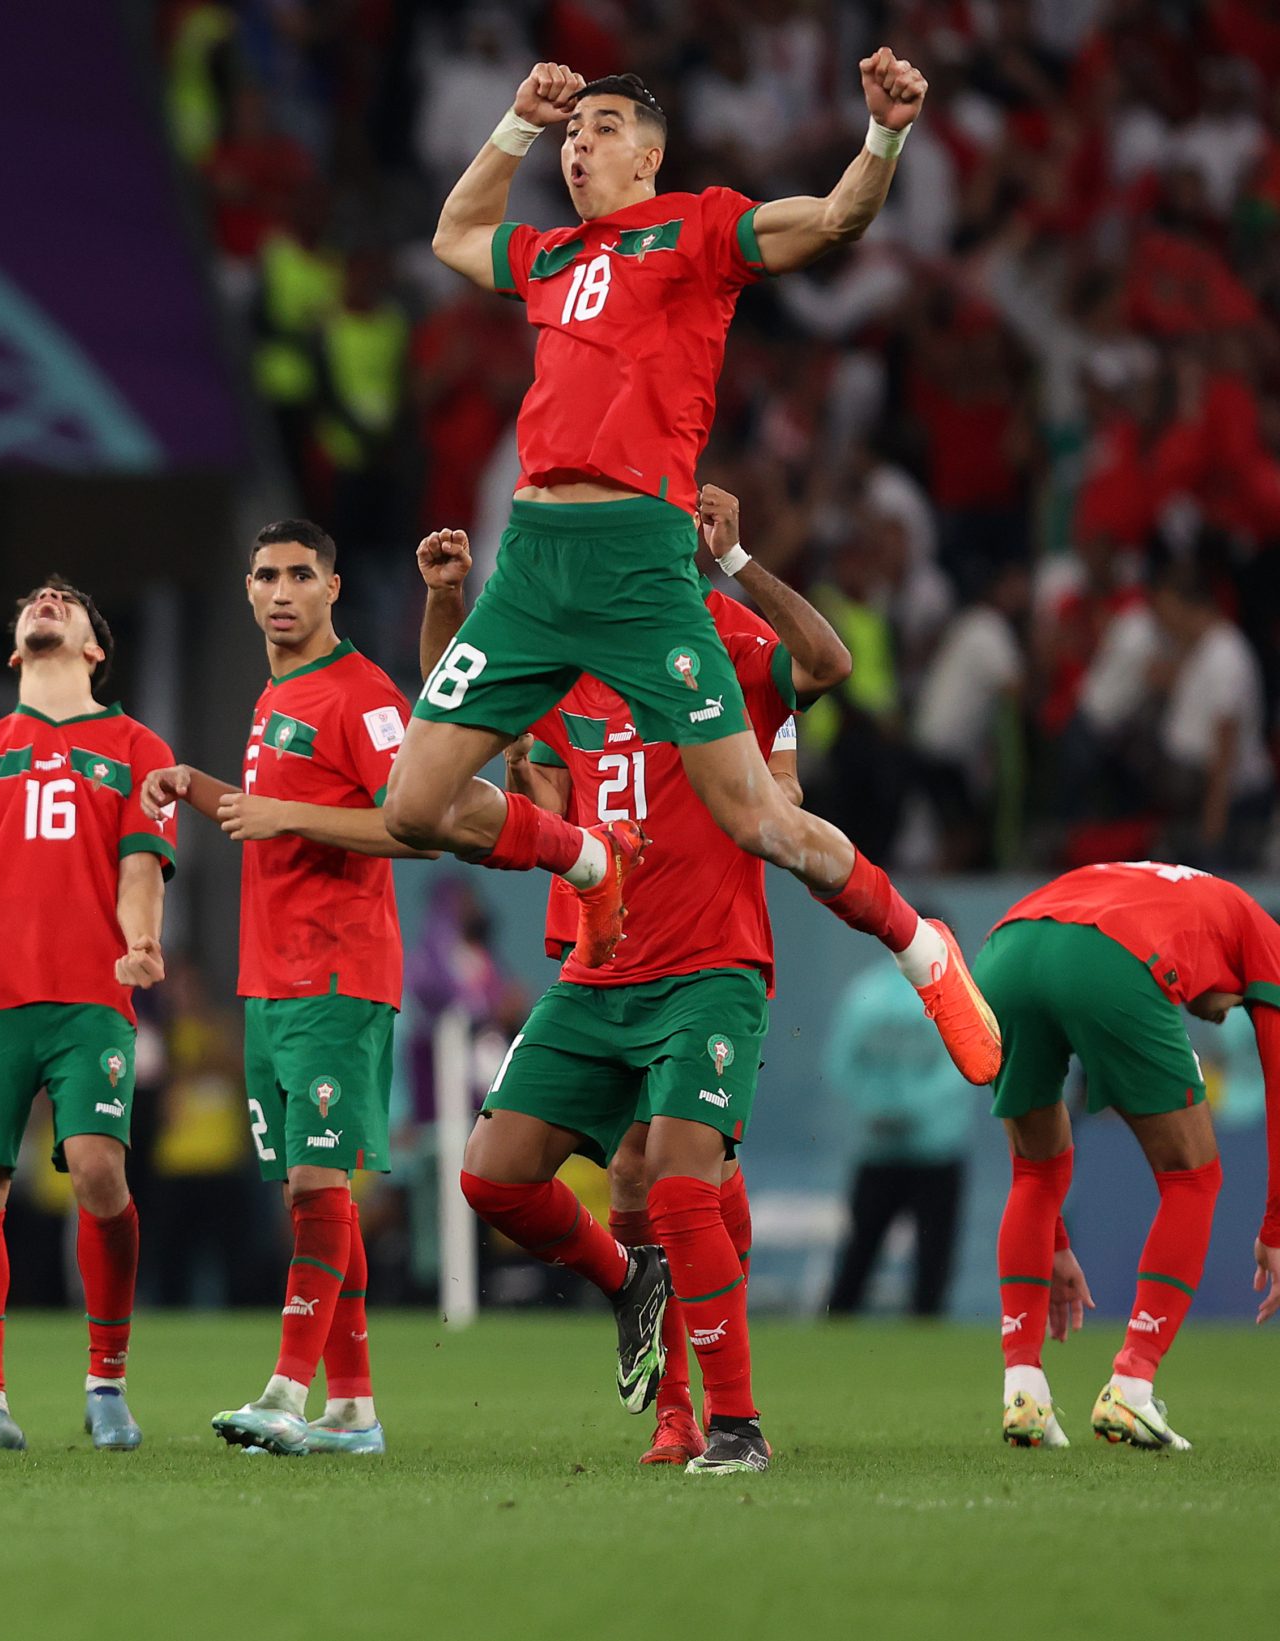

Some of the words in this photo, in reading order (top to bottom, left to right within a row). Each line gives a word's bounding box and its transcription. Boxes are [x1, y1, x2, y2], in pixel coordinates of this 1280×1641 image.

[561, 254, 612, 325] 18
[419, 636, 487, 710] 18
[689, 705, 720, 723] PUMA
[608, 732, 632, 743] PUMA
[35, 758, 62, 770] PUMA
[598, 752, 647, 822] 21
[25, 779, 76, 840] 16
[699, 1089, 725, 1108] PUMA
[95, 1102, 121, 1117] PUMA
[307, 1136, 335, 1148] PUMA
